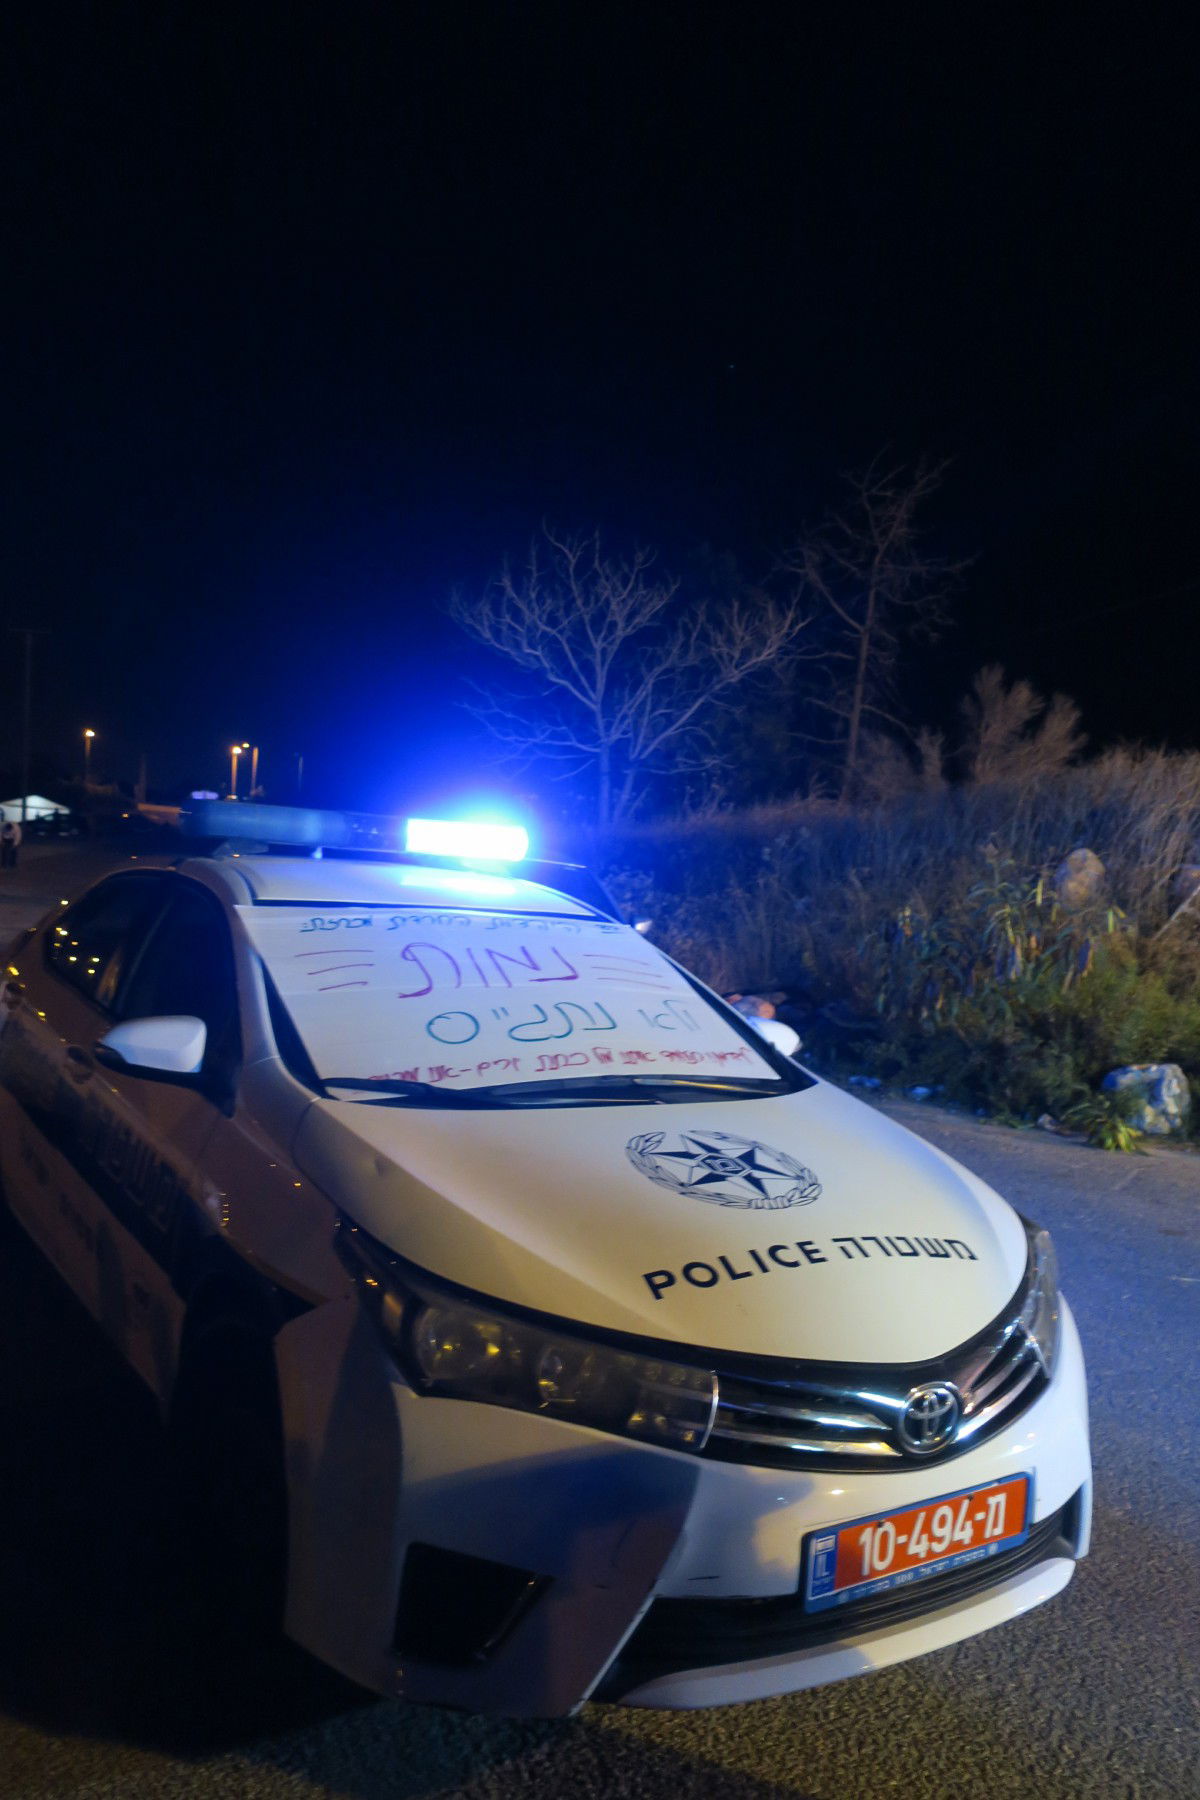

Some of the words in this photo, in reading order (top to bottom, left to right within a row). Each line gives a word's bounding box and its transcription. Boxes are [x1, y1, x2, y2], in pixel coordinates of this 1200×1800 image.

[397, 941, 579, 999] נמות
[637, 999, 702, 1032] ולא
[643, 1240, 828, 1301] POLICE
[832, 1236, 979, 1261] משטרה
